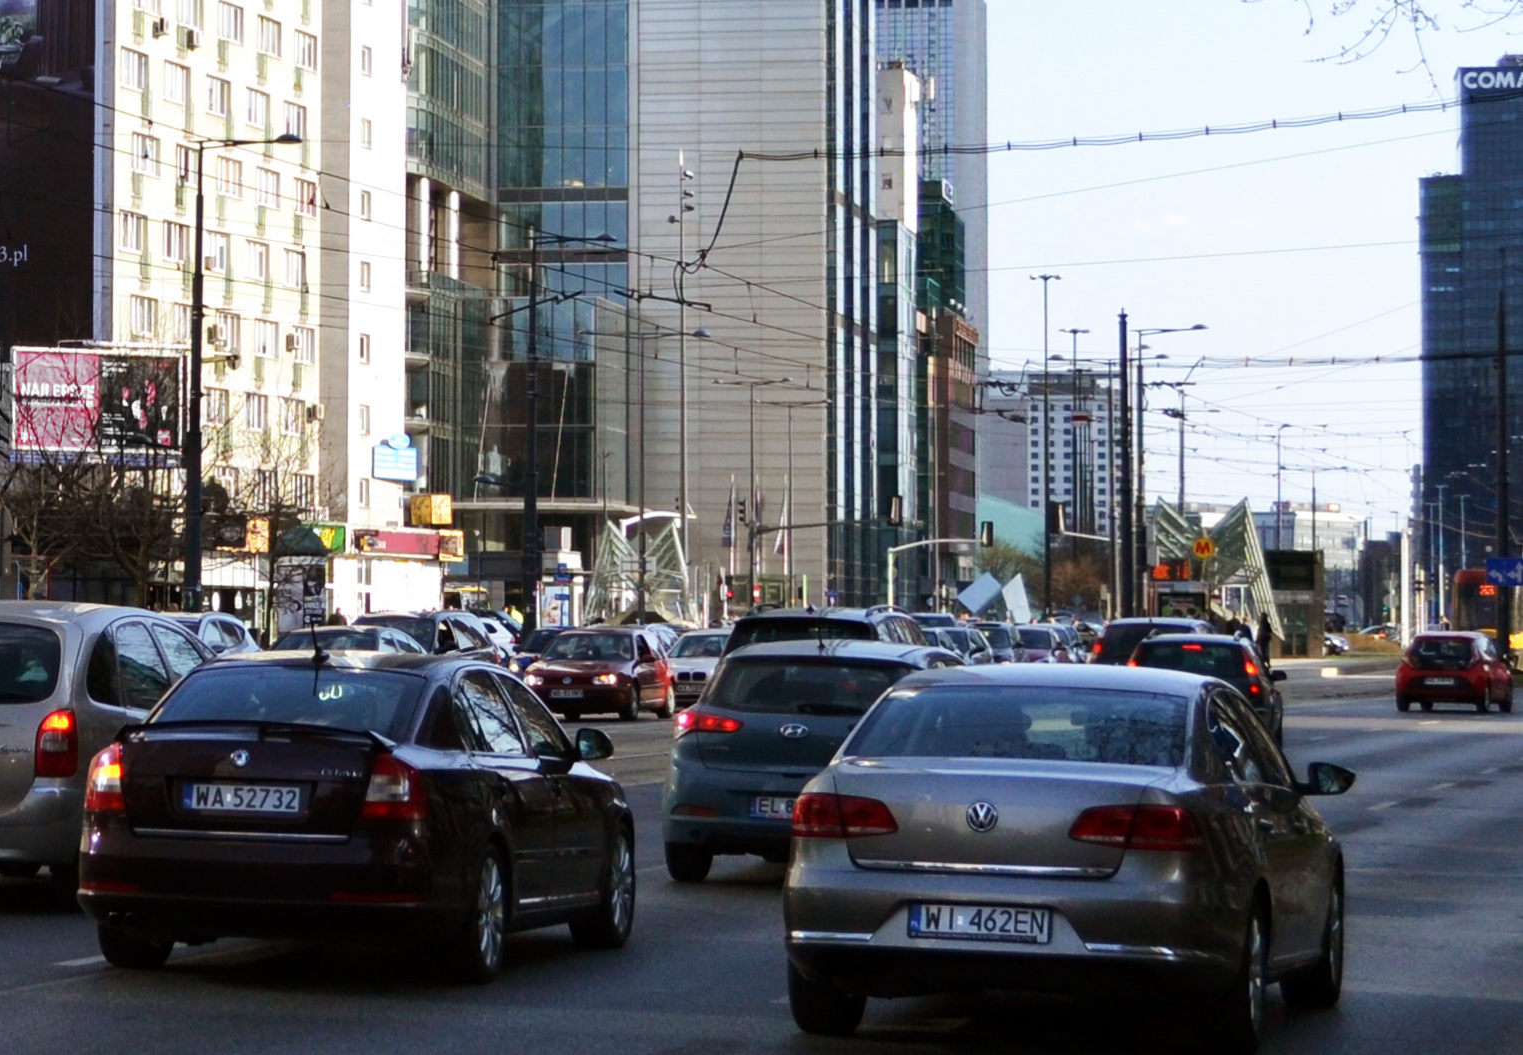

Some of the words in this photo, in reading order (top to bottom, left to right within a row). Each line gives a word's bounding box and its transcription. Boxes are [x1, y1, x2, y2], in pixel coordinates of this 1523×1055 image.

[195, 786, 224, 807] WA
[233, 787, 297, 810] 52732
[758, 799, 779, 813] EL
[925, 906, 954, 930] WI
[969, 908, 1045, 934] 462EN
